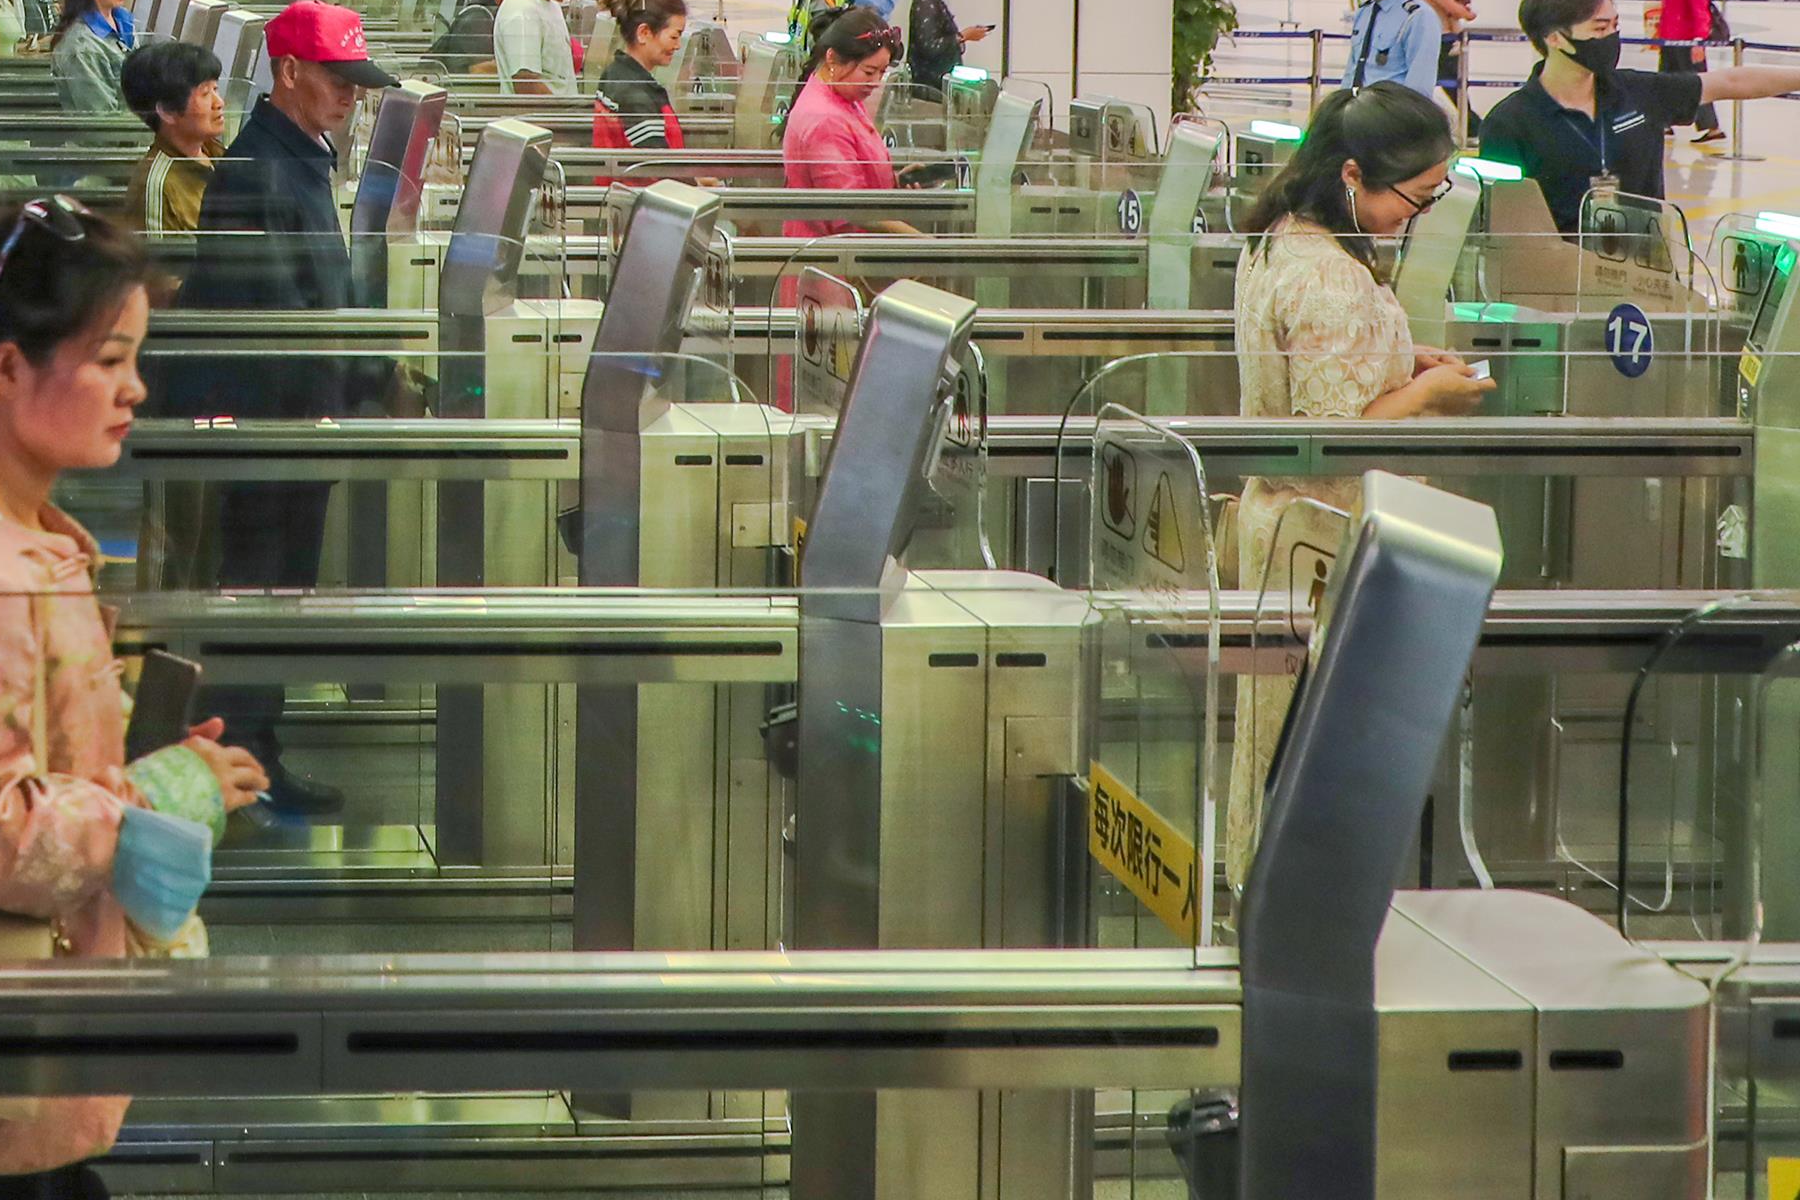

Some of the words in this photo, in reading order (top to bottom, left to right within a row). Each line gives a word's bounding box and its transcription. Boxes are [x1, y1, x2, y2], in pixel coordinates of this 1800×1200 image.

[1118, 199, 1139, 230] 15
[1609, 316, 1648, 364] 17
[1094, 783, 1197, 920] 每次限行一人
